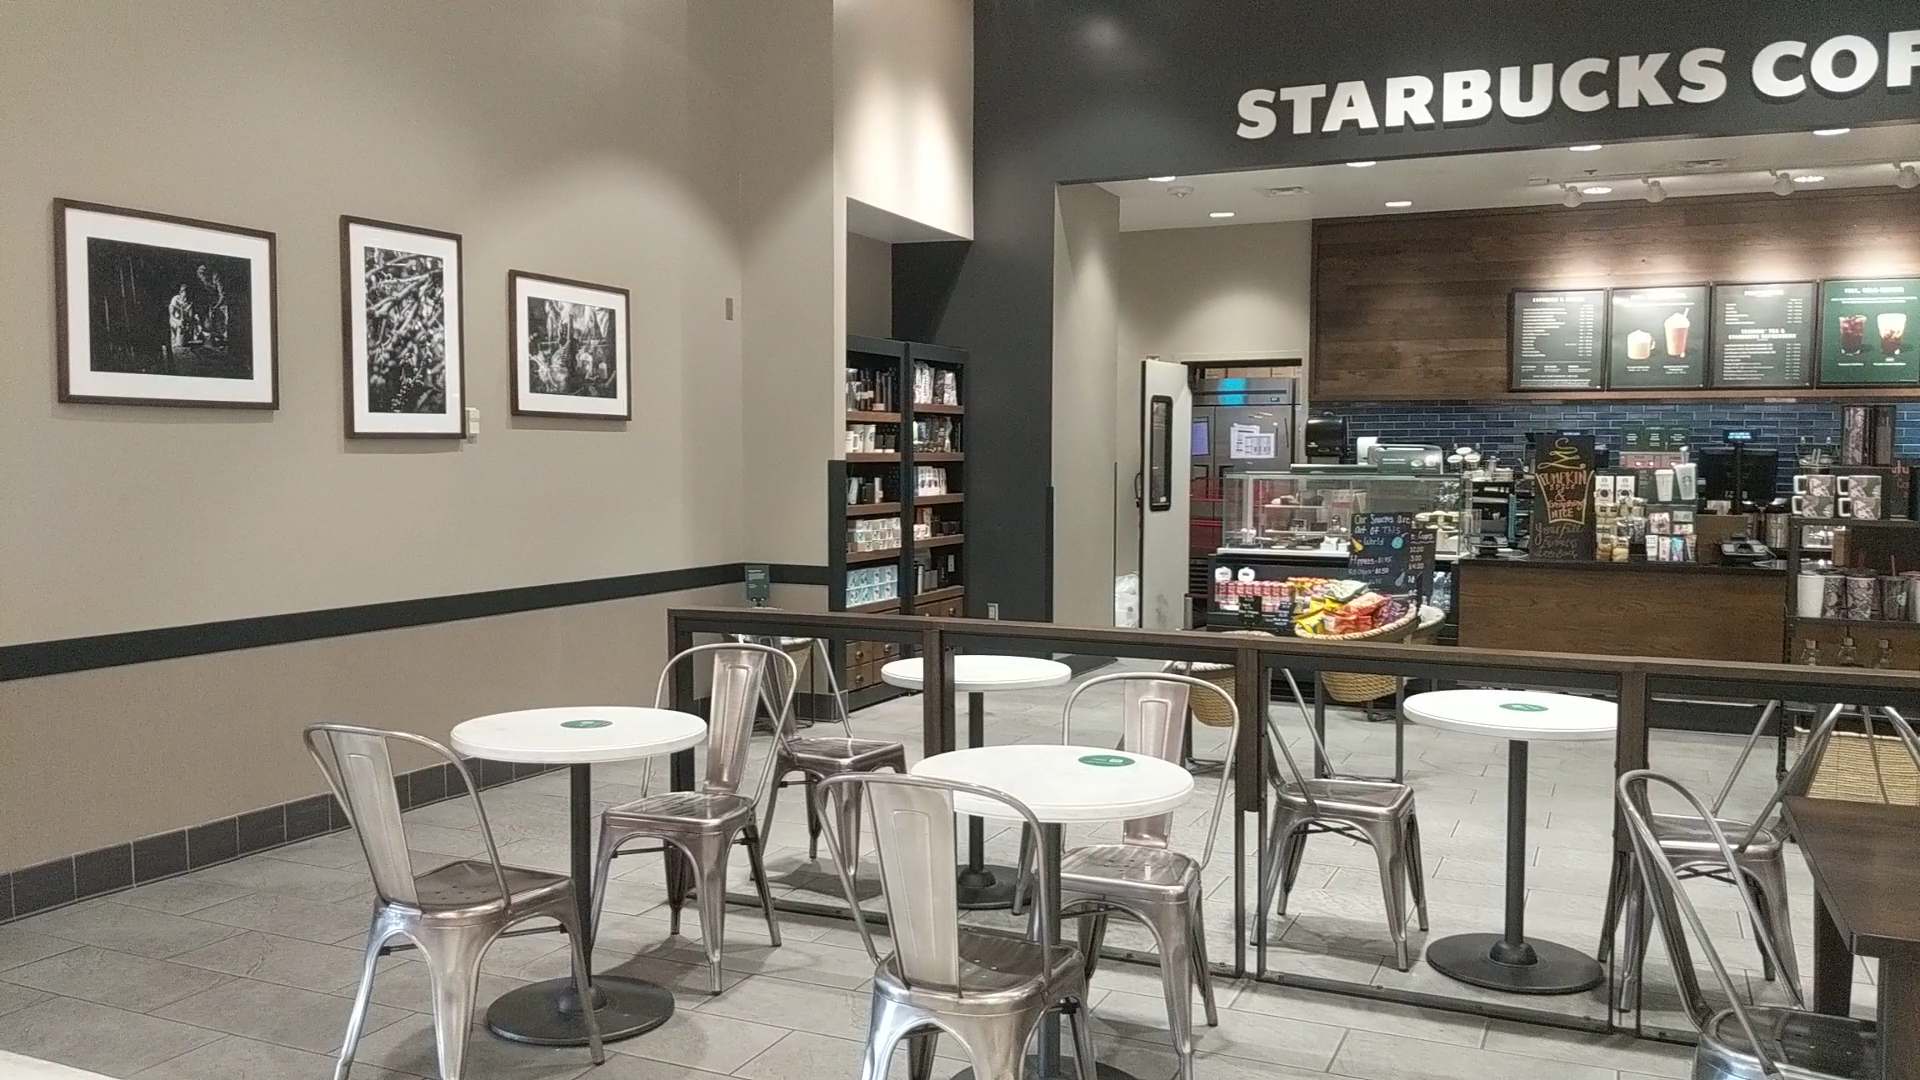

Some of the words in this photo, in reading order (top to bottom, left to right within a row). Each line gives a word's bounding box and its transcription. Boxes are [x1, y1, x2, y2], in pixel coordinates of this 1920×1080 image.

[1236, 47, 1728, 139] STARBUCKS
[1539, 469, 1588, 487] PUMPKIN
[1554, 489, 1566, 502] &
[1354, 514, 1367, 524] Our
[1370, 513, 1394, 524] Snacks
[1551, 508, 1574, 519] NICE
